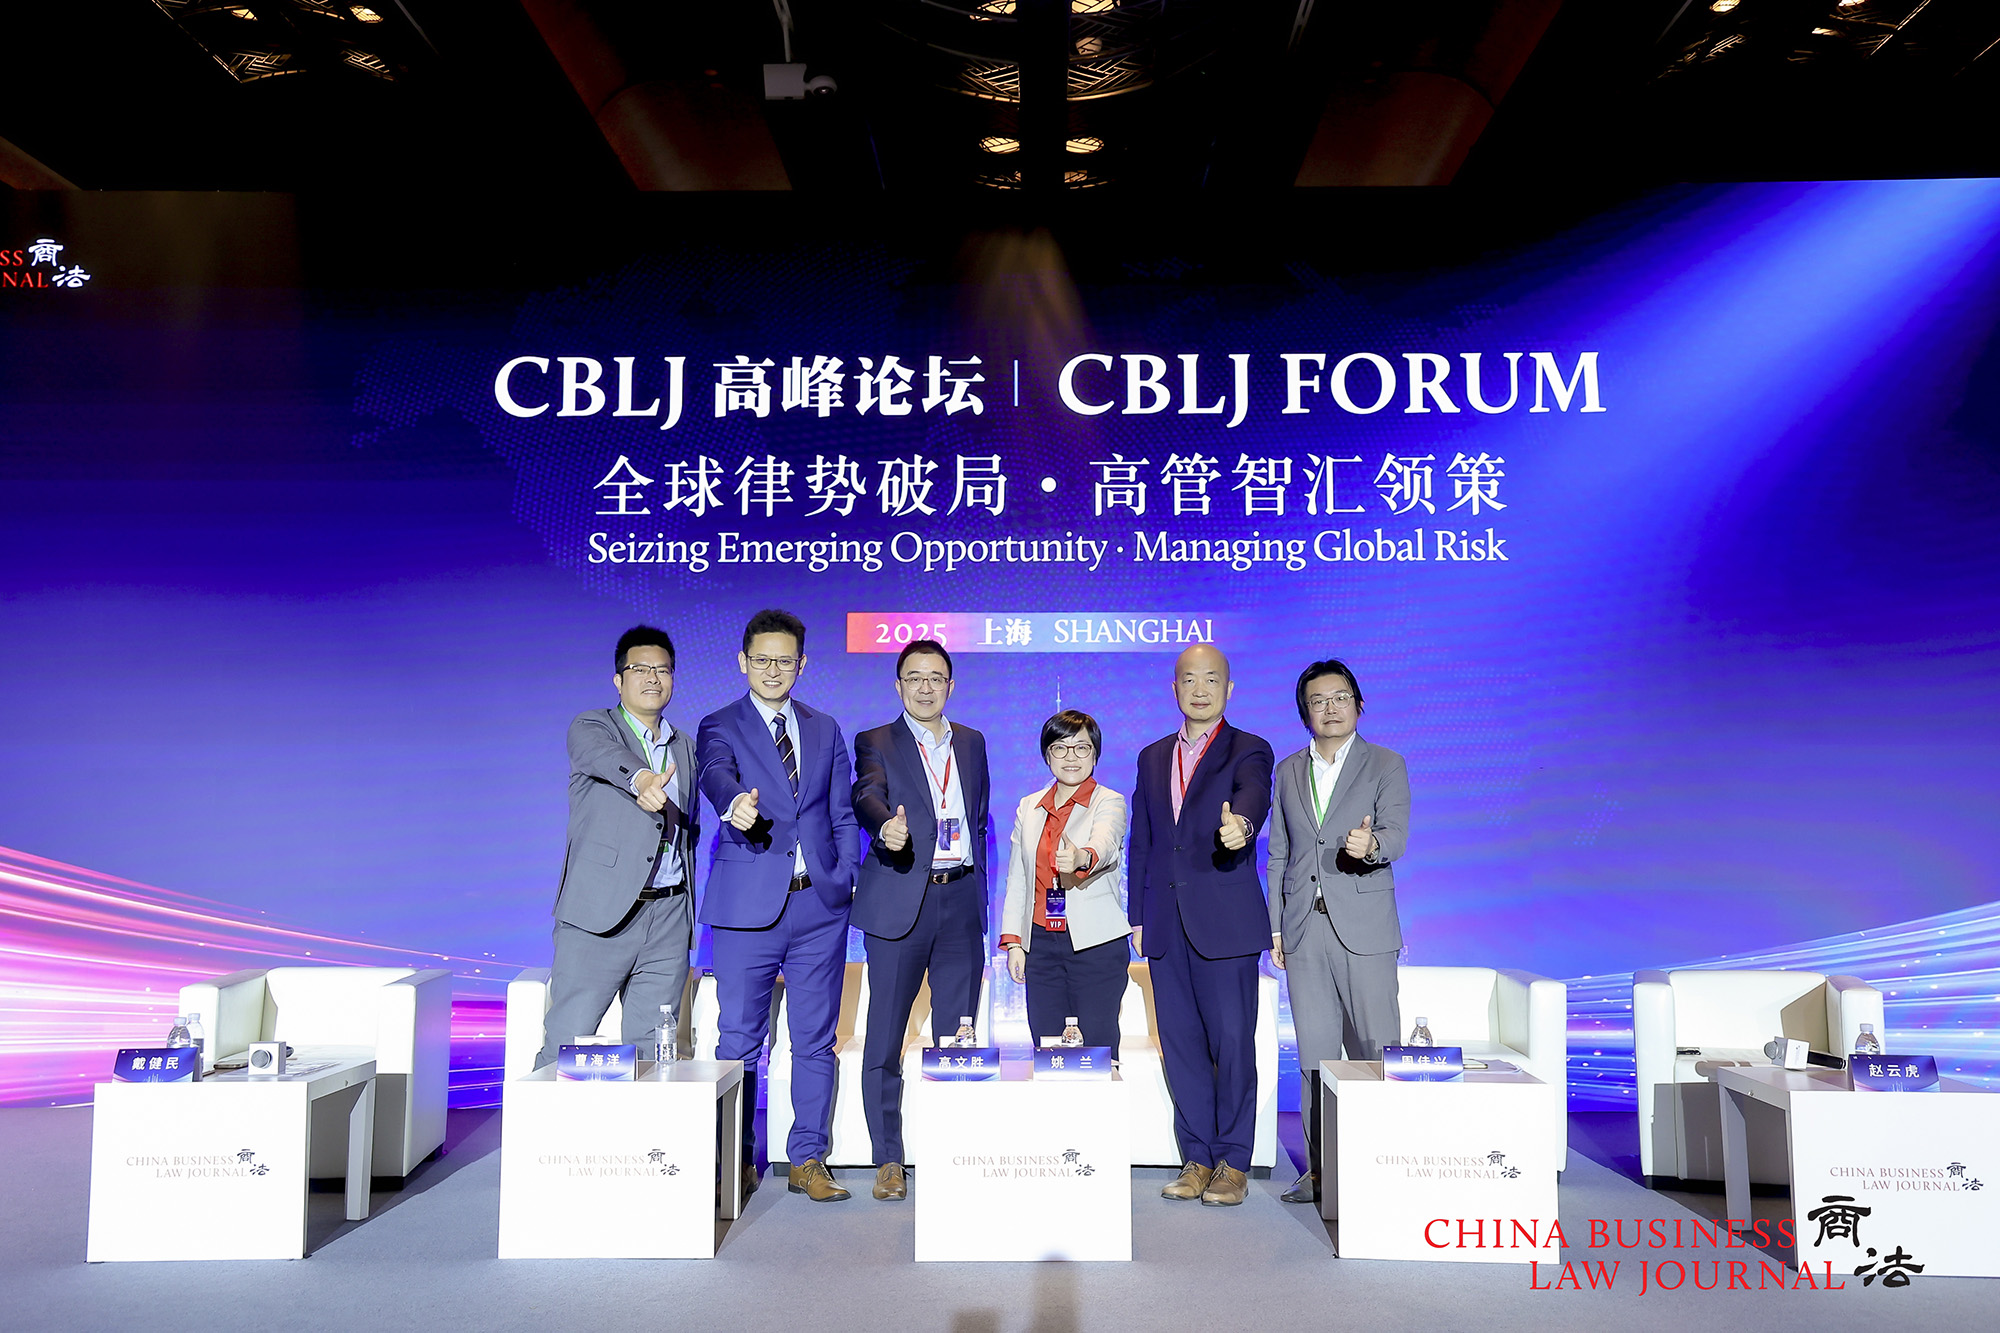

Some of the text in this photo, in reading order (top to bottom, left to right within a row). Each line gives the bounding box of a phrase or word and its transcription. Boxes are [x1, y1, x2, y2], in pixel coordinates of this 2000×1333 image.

[494, 354, 986, 430] CBLJ 高峰论坛
[1058, 351, 1607, 428] CBLJ FORUM
[588, 527, 1509, 573] Seizing Emerging Opportunity Managing Global Risk
[875, 618, 1214, 646] 2025 上海 SHANGHAI
[131, 1056, 179, 1071] 戴健民
[575, 1053, 620, 1067] 曹海洋
[938, 1056, 984, 1070] 高文胜
[1868, 1063, 1920, 1078] 赵云虎
[126, 1155, 234, 1166] CHINA BUSINESS
[538, 1155, 645, 1164] CHINA BUSINESS
[952, 1156, 1060, 1165] CHINA BUSINESS
[1375, 1155, 1485, 1166] CHINA BUSINESS
[156, 1168, 247, 1178] LAW JOURNAL
[568, 1167, 658, 1178] LAW JOURNAL
[983, 1168, 1073, 1179] LAW JOURNAL
[1406, 1168, 1499, 1179] LAW JOURNAL
[1829, 1166, 1944, 1178] CHINA BUSINESS
[1862, 1180, 1960, 1192] LAW JOURNAL
